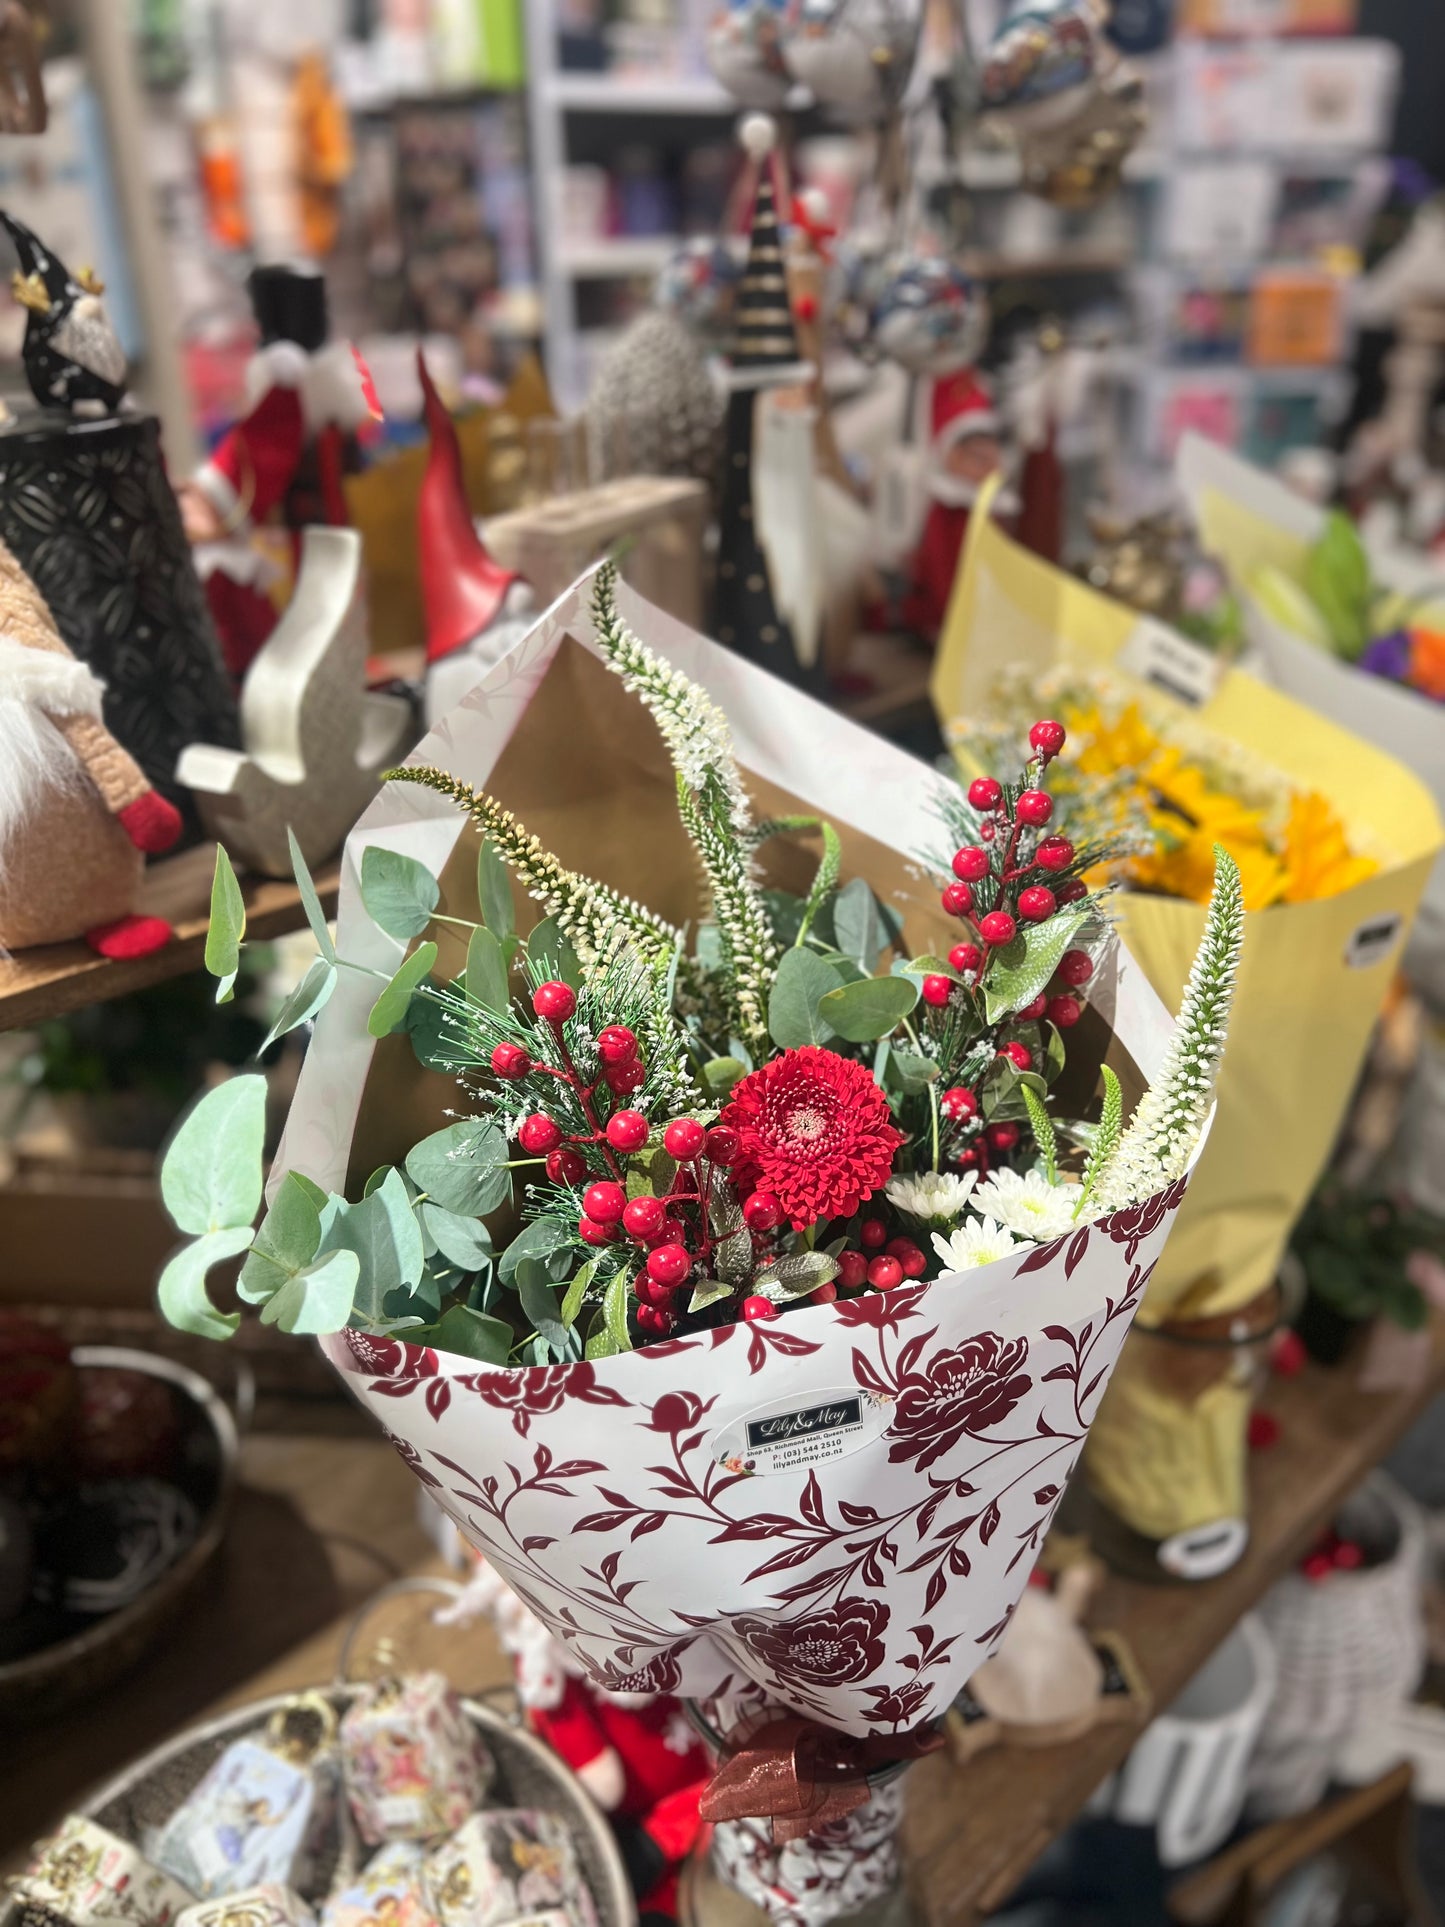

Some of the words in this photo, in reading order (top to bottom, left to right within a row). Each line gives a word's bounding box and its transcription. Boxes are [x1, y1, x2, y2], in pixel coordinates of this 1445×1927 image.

[747, 1449, 761, 1457] Shop
[775, 1438, 805, 1450] Richmond
[806, 1434, 822, 1443] Mall,
[823, 1430, 844, 1439] Queen
[845, 1425, 864, 1433] Street
[783, 1449, 801, 1459] (03)
[803, 1443, 819, 1453] 544
[821, 1438, 842, 1449] 2510
[773, 1448, 843, 1469] lilyandmay.co.nz
